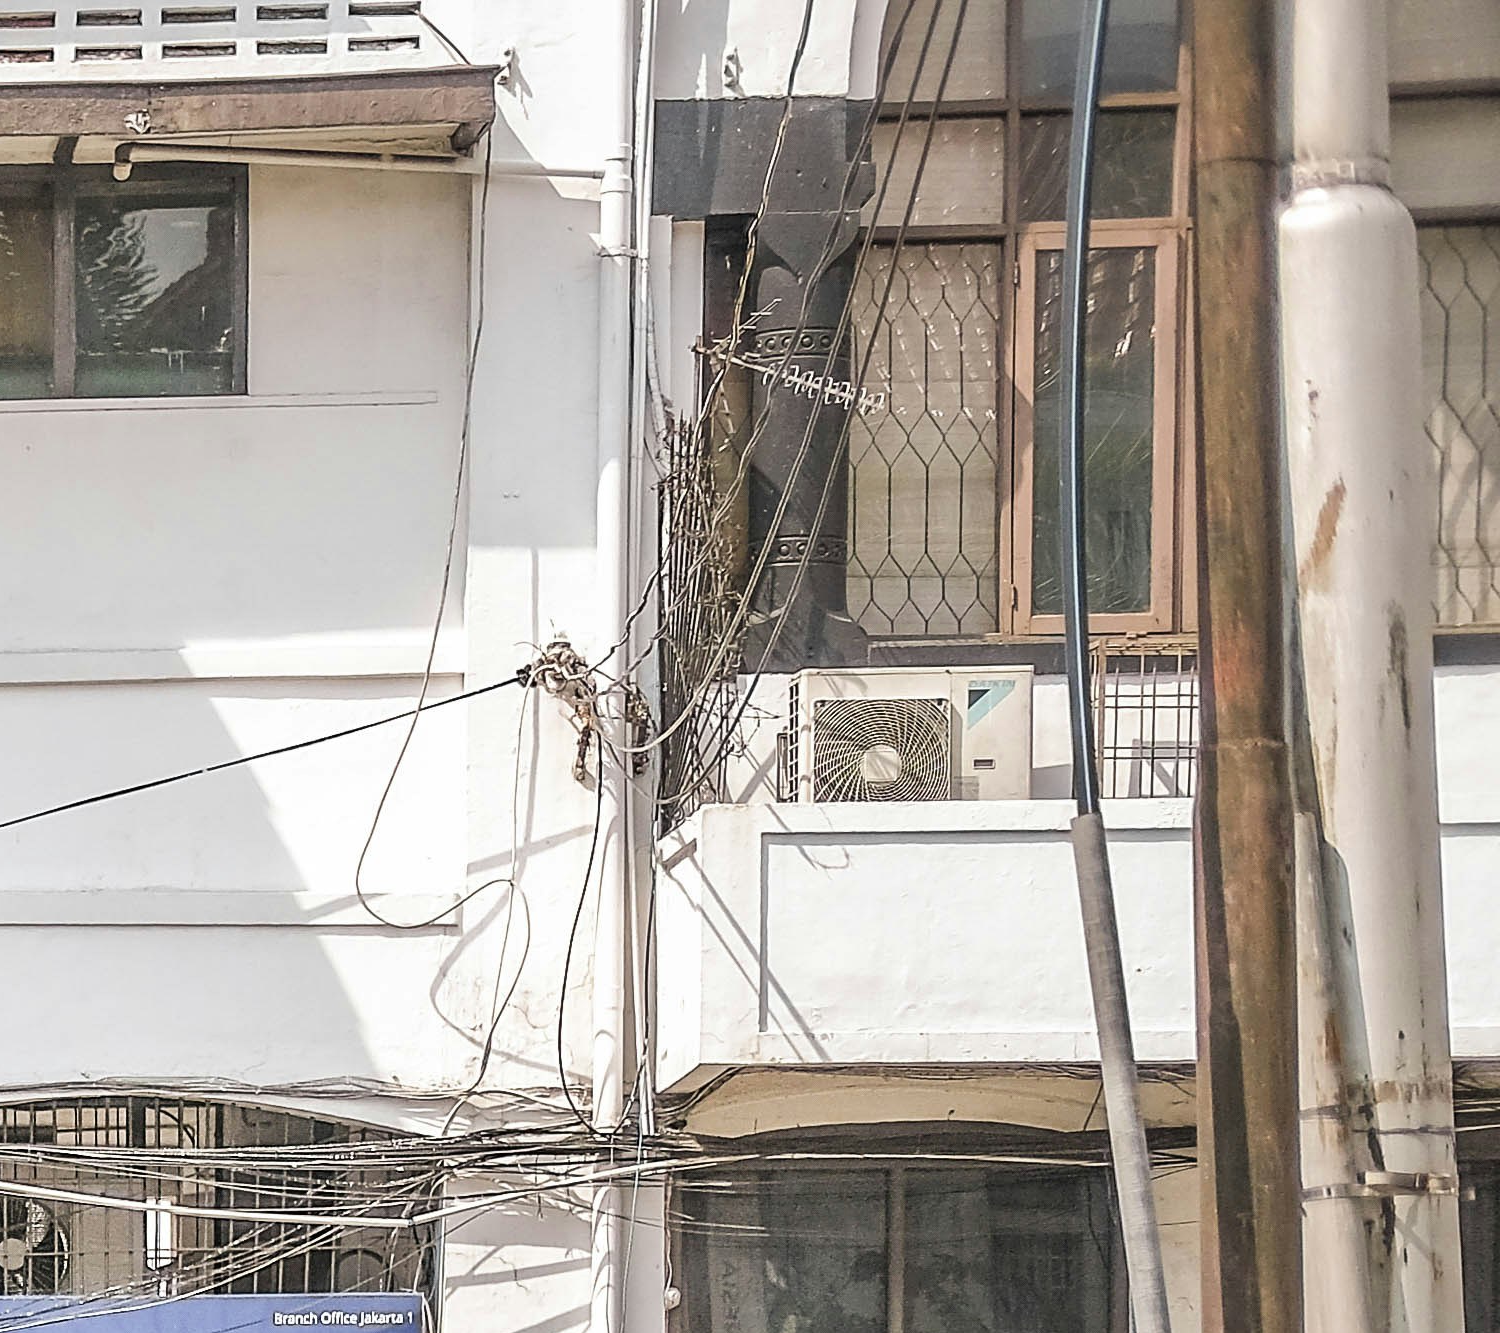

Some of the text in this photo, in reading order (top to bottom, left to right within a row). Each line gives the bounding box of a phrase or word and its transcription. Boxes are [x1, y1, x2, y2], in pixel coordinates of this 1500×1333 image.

[273, 1311, 413, 1327] Branch Office Jakarta 1
